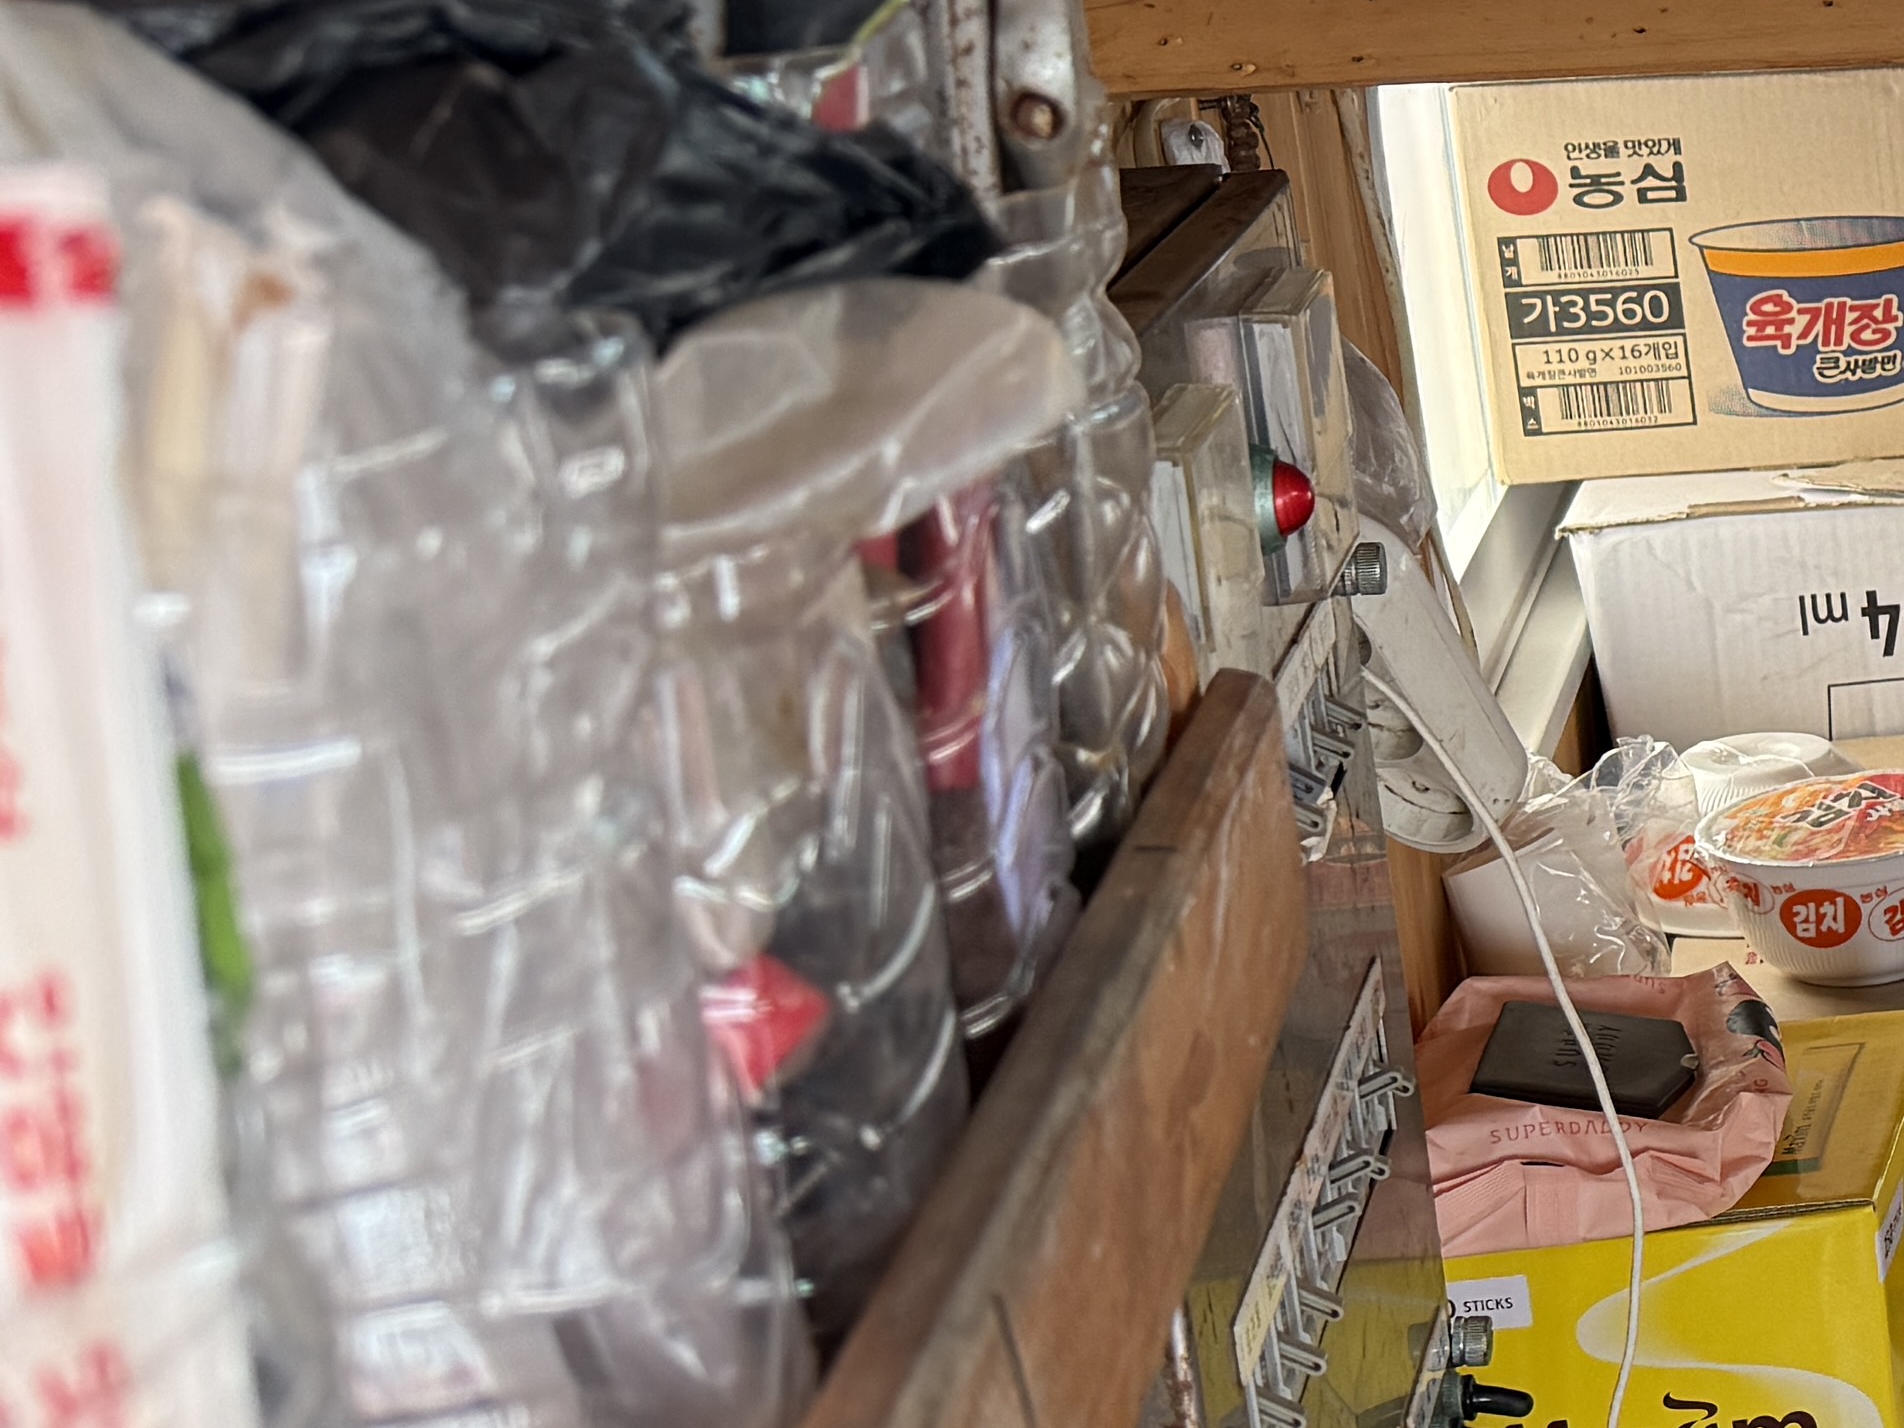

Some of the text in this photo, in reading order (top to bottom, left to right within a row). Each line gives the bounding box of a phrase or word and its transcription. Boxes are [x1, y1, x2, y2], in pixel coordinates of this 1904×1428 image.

[1563, 136, 1683, 162] 인생을 맛있게
[1568, 159, 1688, 210] 농심
[1521, 289, 1671, 333] 가3560
[1744, 291, 1903, 353] 육개장
[1543, 346, 1581, 363] 110
[1618, 362, 1683, 376] 101003560
[1815, 352, 1901, 380] 큰사발면
[1799, 591, 1850, 637] ml
[1791, 897, 1846, 939] 김치
[1462, 1295, 1514, 1314] STICKS
